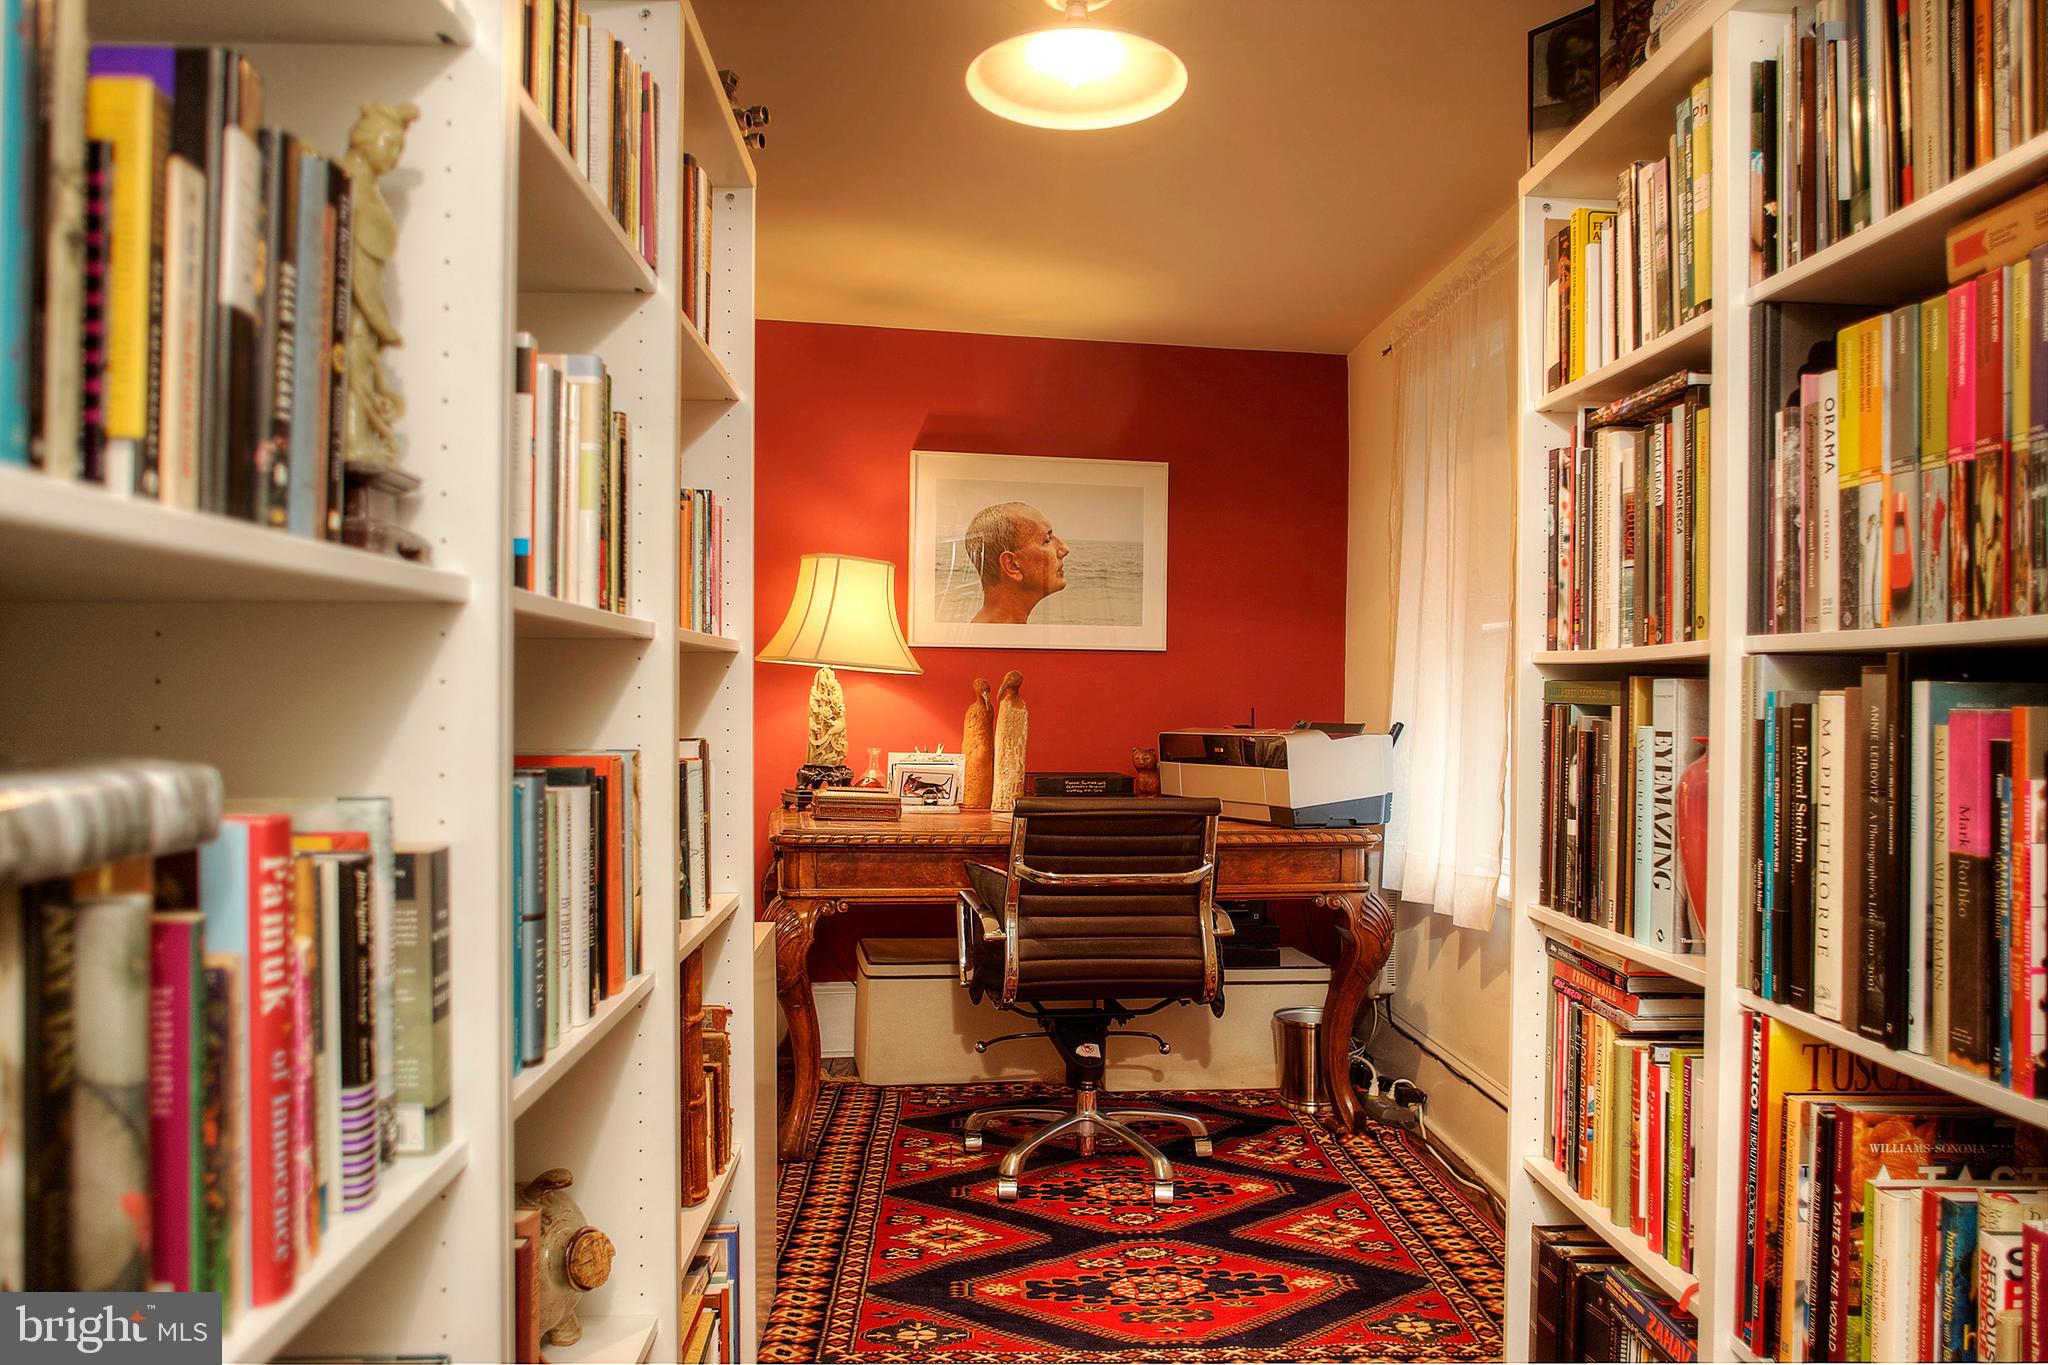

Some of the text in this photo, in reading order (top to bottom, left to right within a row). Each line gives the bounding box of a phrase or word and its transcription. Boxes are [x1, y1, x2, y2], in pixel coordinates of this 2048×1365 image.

[1654, 426, 1663, 504] TACITA DEAN
[1823, 396, 1836, 475] OBAMA
[1676, 469, 1684, 535] FRANCESCA
[1807, 520, 1815, 589] Annual Pictorial
[1869, 705, 1879, 742] ANNIE
[1636, 738, 1646, 866] WATERPROOF
[1795, 745, 1808, 863] Edward Steichen
[1869, 745, 1879, 804] LEIBOVITZ
[1653, 730, 1673, 891] EYEMAZING
[1818, 718, 1832, 959] MAPPLETHORPE
[1866, 824, 1879, 898] Photographer's
[1935, 736, 1944, 993] SALLY MANN WHAT REMAINS
[1957, 806, 1971, 919] Mark Rothko
[2000, 802, 2008, 917] ALMOST PARADISE
[258, 856, 293, 1018] Pamuk
[561, 913, 570, 969] FIREFLIES
[588, 913, 596, 948] world
[2012, 841, 2024, 993] First Comes Love
[536, 937, 544, 1010] IRVING
[1572, 970, 1596, 990] FRENCH
[1597, 979, 1617, 1002] GRILL
[1579, 1037, 1587, 1074] BOOK
[1579, 1098, 1587, 1140] SOUPS
[1668, 1089, 1676, 1122] garten
[271, 1049, 291, 1262] of Innocence
[1669, 1130, 1677, 1155] cook
[1669, 1156, 1677, 1173] like
[1748, 1134, 1758, 1184] BEAUTIFUL
[1787, 1138, 1796, 1182] Complete
[1869, 1142, 1986, 1154] WILLIAMS-SONOMA
[1682, 1162, 1691, 1217] foolproof
[1747, 1184, 1756, 1248] COOKBOOK
[1786, 1183, 1794, 1209] Book
[1785, 1222, 1793, 1248] Sushi
[1945, 1230, 1957, 1268] home
[1828, 1184, 1842, 1353] A TASTE OF THE WORLD
[1863, 1260, 1873, 1339] Almost Vegetarian
[1880, 1258, 1889, 1323] Cooking with
[1943, 1269, 1957, 1323] cooking
[2030, 1242, 2041, 1320] Recollections
[1645, 1312, 1692, 1363] ZAHAV
[1984, 1255, 1998, 1362] SERIOUS
[2030, 1320, 2041, 1344] and
